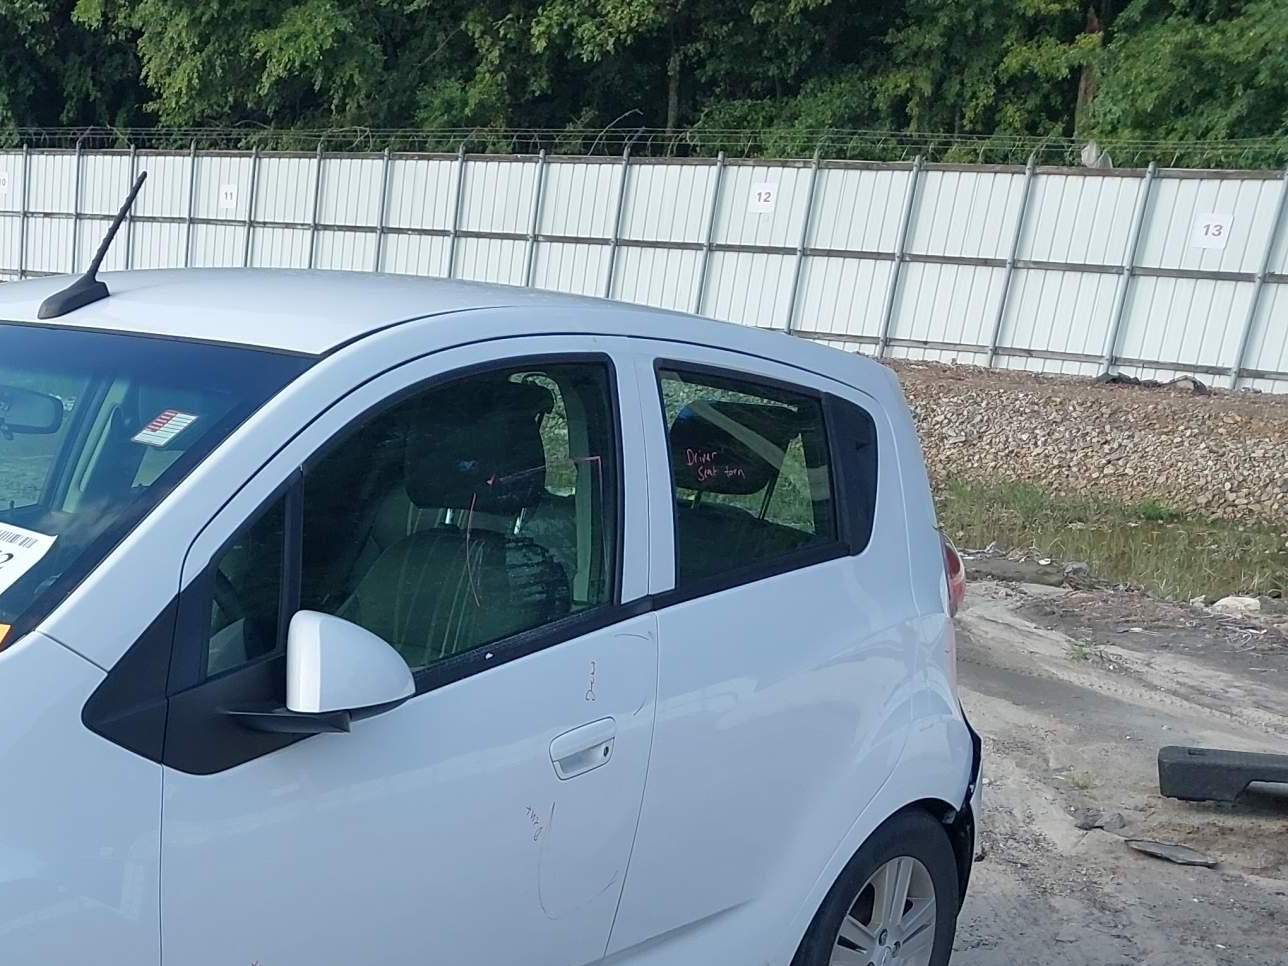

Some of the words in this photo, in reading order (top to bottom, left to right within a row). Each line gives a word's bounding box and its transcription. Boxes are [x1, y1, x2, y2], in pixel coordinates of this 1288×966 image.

[224, 191, 233, 201] 11
[757, 191, 772, 203] 12
[1203, 223, 1223, 237] 13
